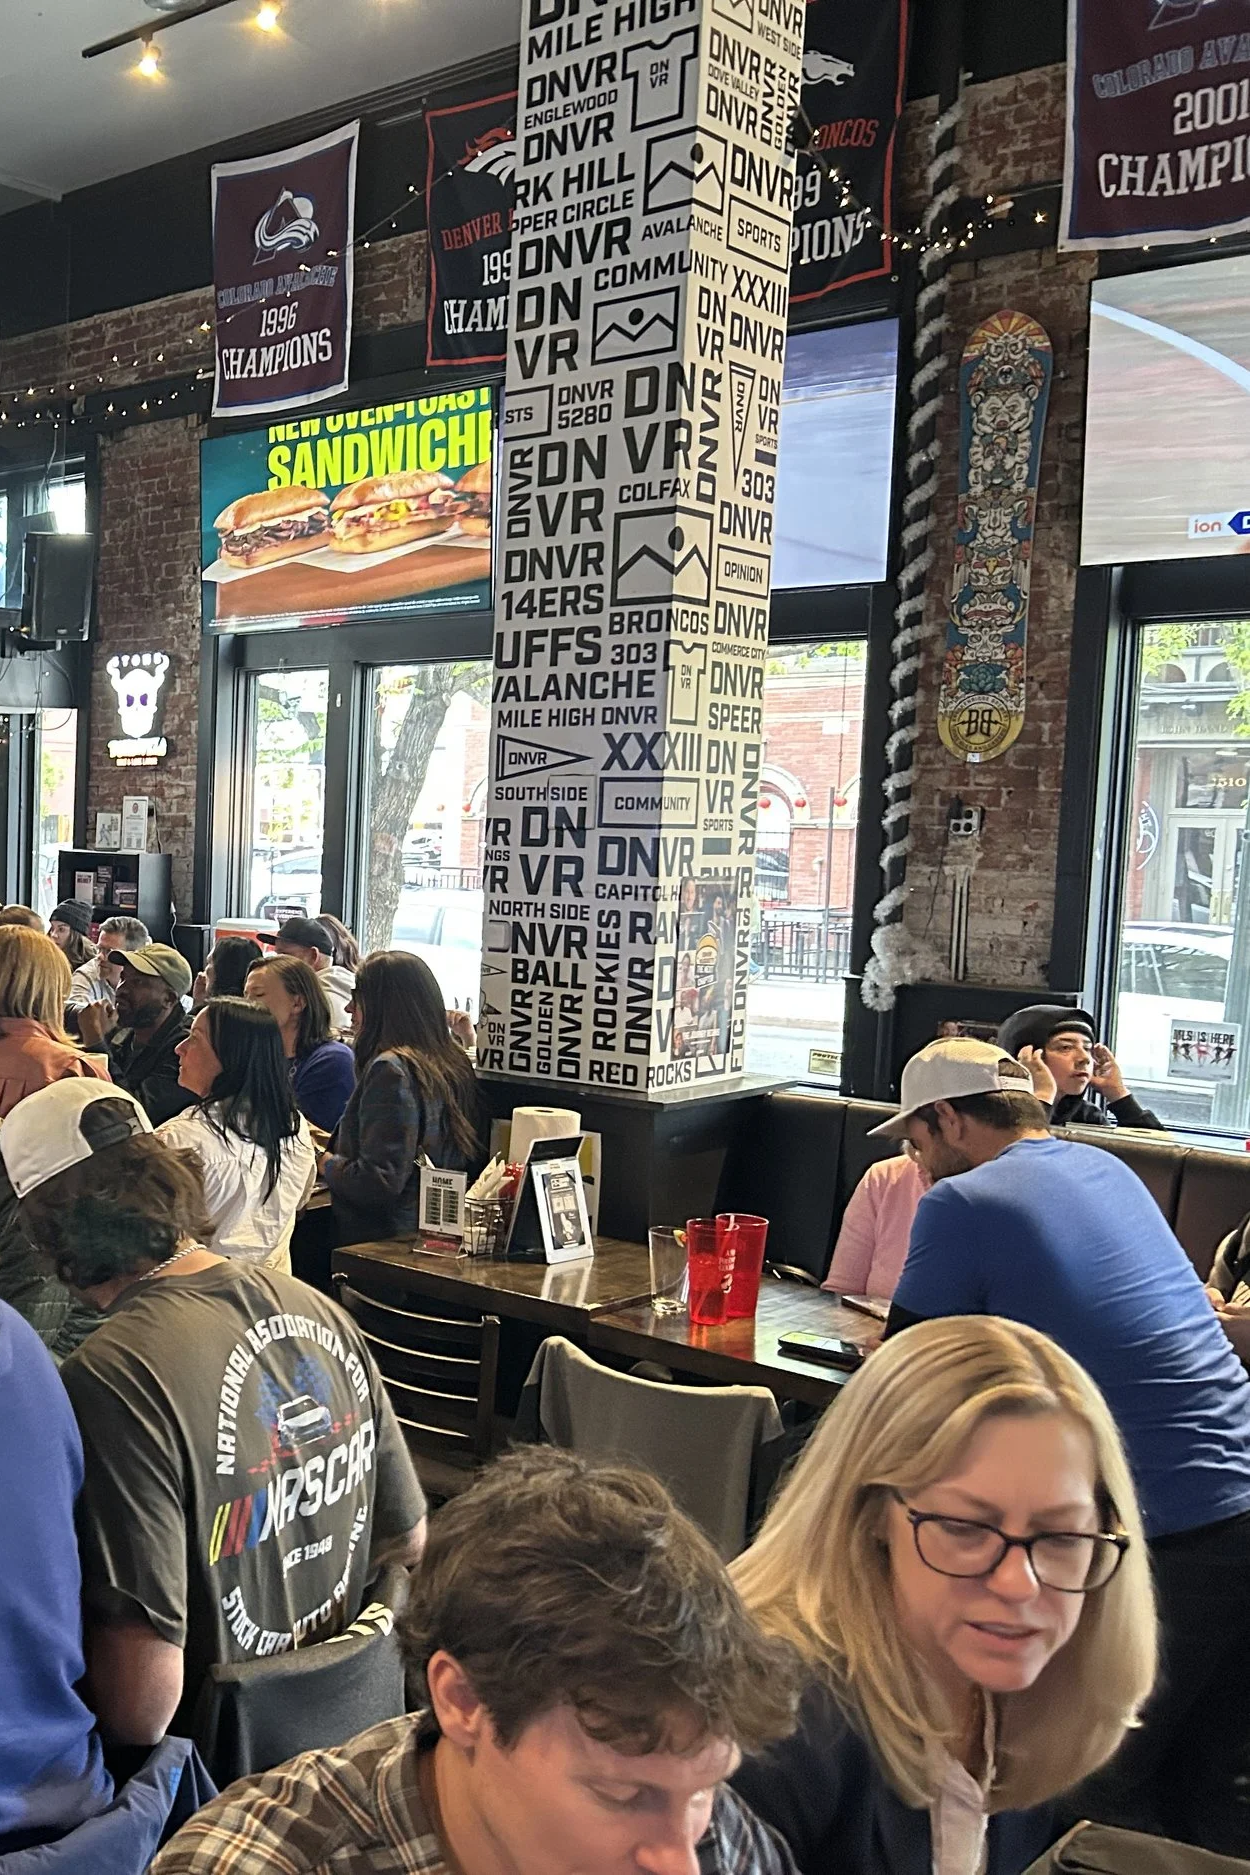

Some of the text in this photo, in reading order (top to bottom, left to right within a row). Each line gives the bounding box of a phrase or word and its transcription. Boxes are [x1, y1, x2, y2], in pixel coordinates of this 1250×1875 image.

[528, 14, 604, 65] MILE
[615, 0, 696, 36] HIGH
[757, 21, 801, 60] WEST SIDE
[709, 26, 761, 86] DNVR
[1093, 46, 1194, 98] COLORADO
[526, 50, 617, 109] DNVR
[707, 65, 760, 99] DOVE VALLEY
[525, 89, 619, 130] ENGLEWOOD
[706, 83, 758, 140] DNVR
[760, 57, 777, 146] DNVR
[774, 65, 786, 150] GOLDEN
[1173, 78, 1249, 135] 2001
[524, 111, 614, 167] DNVR
[563, 152, 635, 198] HILL
[729, 143, 794, 211] DNVR
[1098, 135, 1250, 198] CHAMPI
[563, 188, 635, 224] CIRCLE
[442, 216, 501, 250] DENVER
[518, 216, 631, 279] DNVR
[641, 214, 723, 242] AVALANCHE
[737, 217, 781, 253] SPORTS
[218, 278, 273, 308] COLORADO
[516, 275, 581, 332] DN
[594, 249, 787, 319] COMMUNITY XXXIII
[260, 302, 298, 337] 1996
[729, 310, 784, 364] DNVR
[222, 328, 332, 380] CHAMPIONS
[515, 328, 579, 380] VR
[558, 378, 614, 406] DNVR
[624, 361, 696, 418] DN
[558, 403, 612, 430] 5280
[696, 368, 723, 505] DNVR
[537, 434, 607, 488] DN
[622, 418, 692, 474] VR
[755, 434, 778, 450] SPORTS
[506, 445, 534, 540] DNVR
[618, 477, 691, 504] COLFAX
[742, 468, 775, 504] 303
[536, 488, 604, 538] VR
[719, 500, 772, 545] DNVR
[1194, 519, 1222, 533] ion
[504, 541, 605, 584] DNVR
[724, 560, 763, 584] OPINION
[502, 584, 604, 621] 14ERS
[608, 608, 709, 636] BRONCOS
[714, 601, 767, 642] DNVR
[611, 643, 657, 665] 303
[712, 642, 766, 660] COMMERCE CITY
[710, 660, 763, 700] DNVR
[497, 706, 658, 728] MILE HIGH DNVR
[708, 703, 762, 734] SPEER
[508, 752, 547, 765] DNVR
[601, 731, 702, 771] XXXIII
[495, 786, 588, 801] SOUTH SIDE
[615, 796, 690, 811] COMMUNITY
[520, 806, 587, 848] DN
[703, 818, 734, 832] SPORTS
[519, 854, 584, 898] VR
[598, 836, 695, 878] DNVR
[489, 900, 590, 921] NORTH SIDE
[595, 883, 668, 902] CAPITOL
[511, 958, 587, 990] BALL
[592, 910, 621, 1052] ROCKIES
[624, 957, 654, 1056] DNVR
[537, 991, 554, 1075] GOLDEN
[557, 993, 583, 1080] DNVR
[1198, 1032, 1206, 1042] IS
[1210, 1032, 1235, 1045] HERE
[589, 1060, 692, 1088] RED ROCKS
[216, 1344, 370, 1475] NATIONAL FOR
[259, 1418, 375, 1542] NASCAR
[305, 1535, 333, 1560] 1948
[222, 1586, 260, 1650] STOCK
[255, 1630, 292, 1656] CAR
